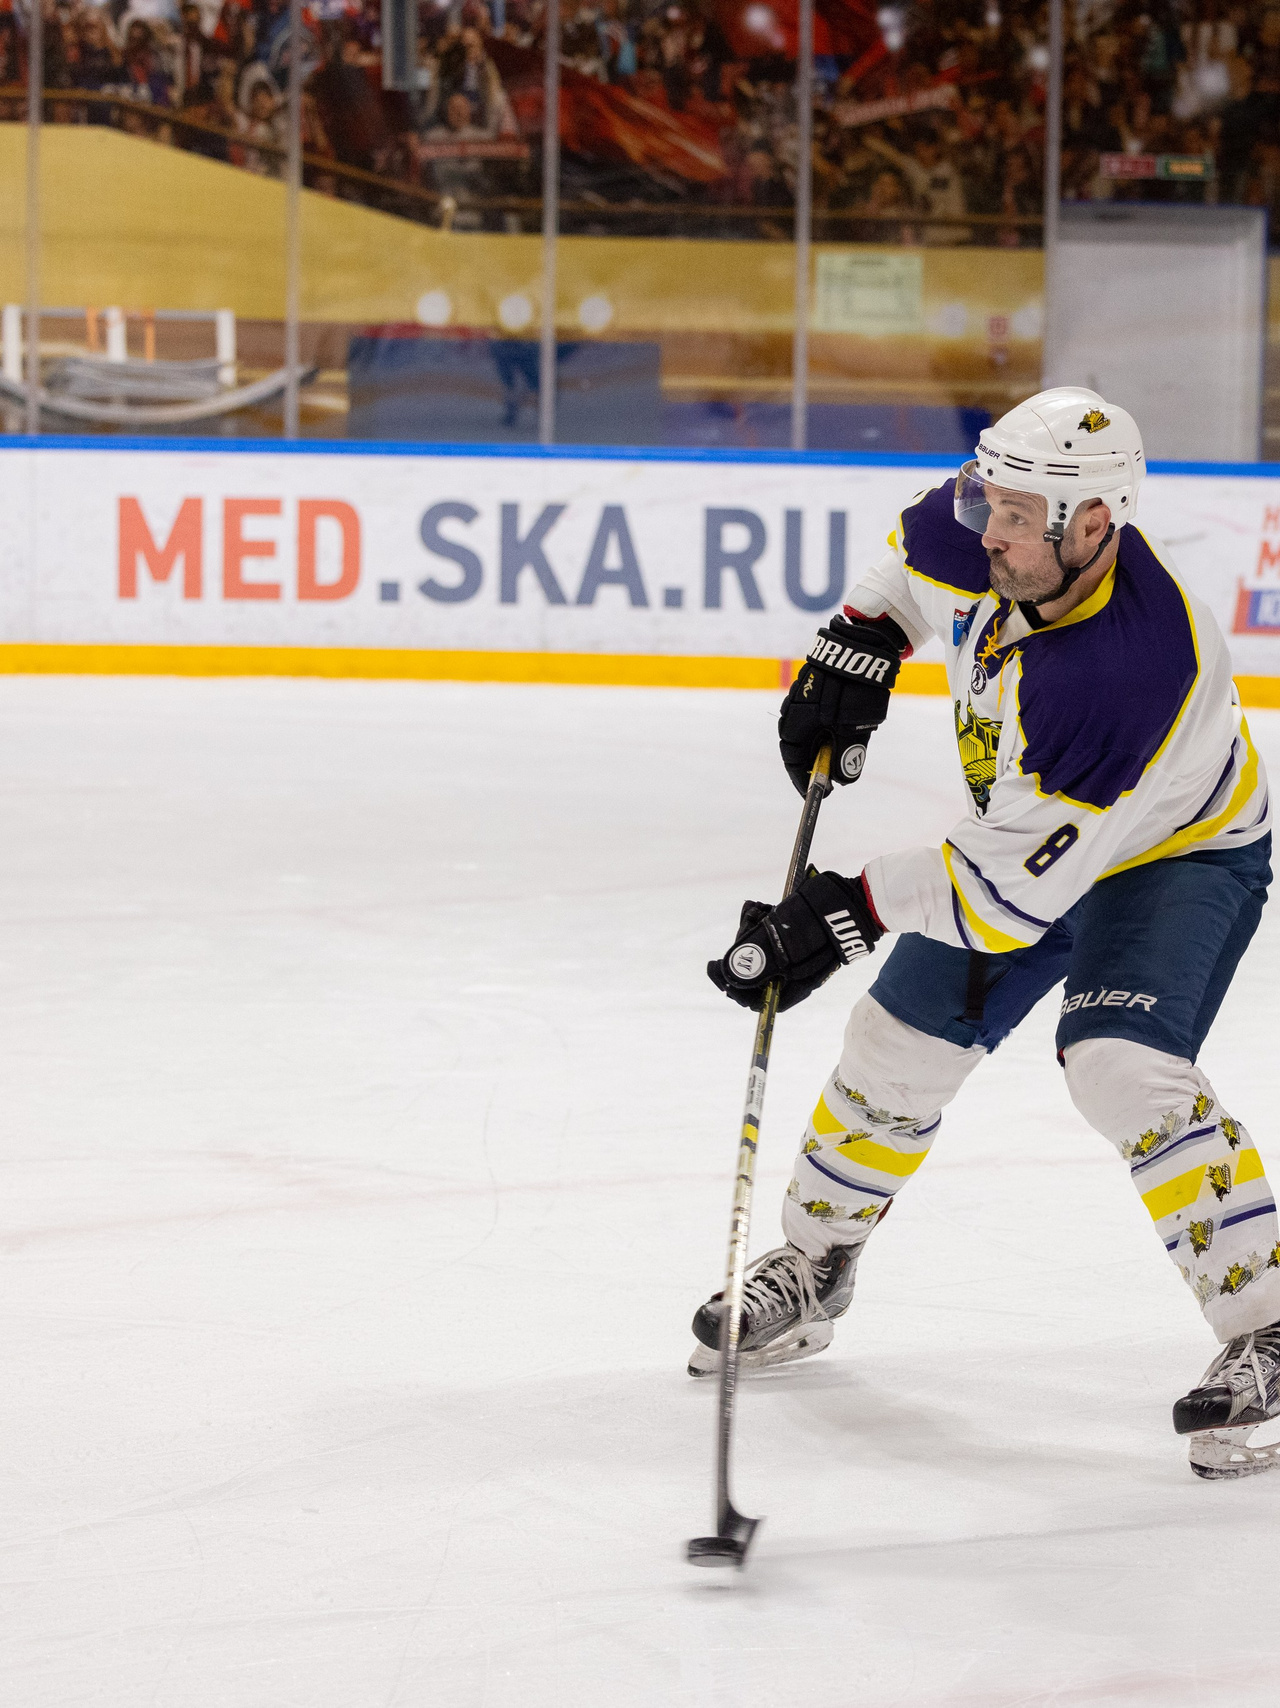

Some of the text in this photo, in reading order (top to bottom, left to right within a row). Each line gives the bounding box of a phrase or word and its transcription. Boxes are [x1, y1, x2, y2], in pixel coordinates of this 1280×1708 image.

[116, 496, 848, 612] MED.SKA.RU
[808, 634, 891, 684] RRIOR
[1023, 822, 1080, 878] 8
